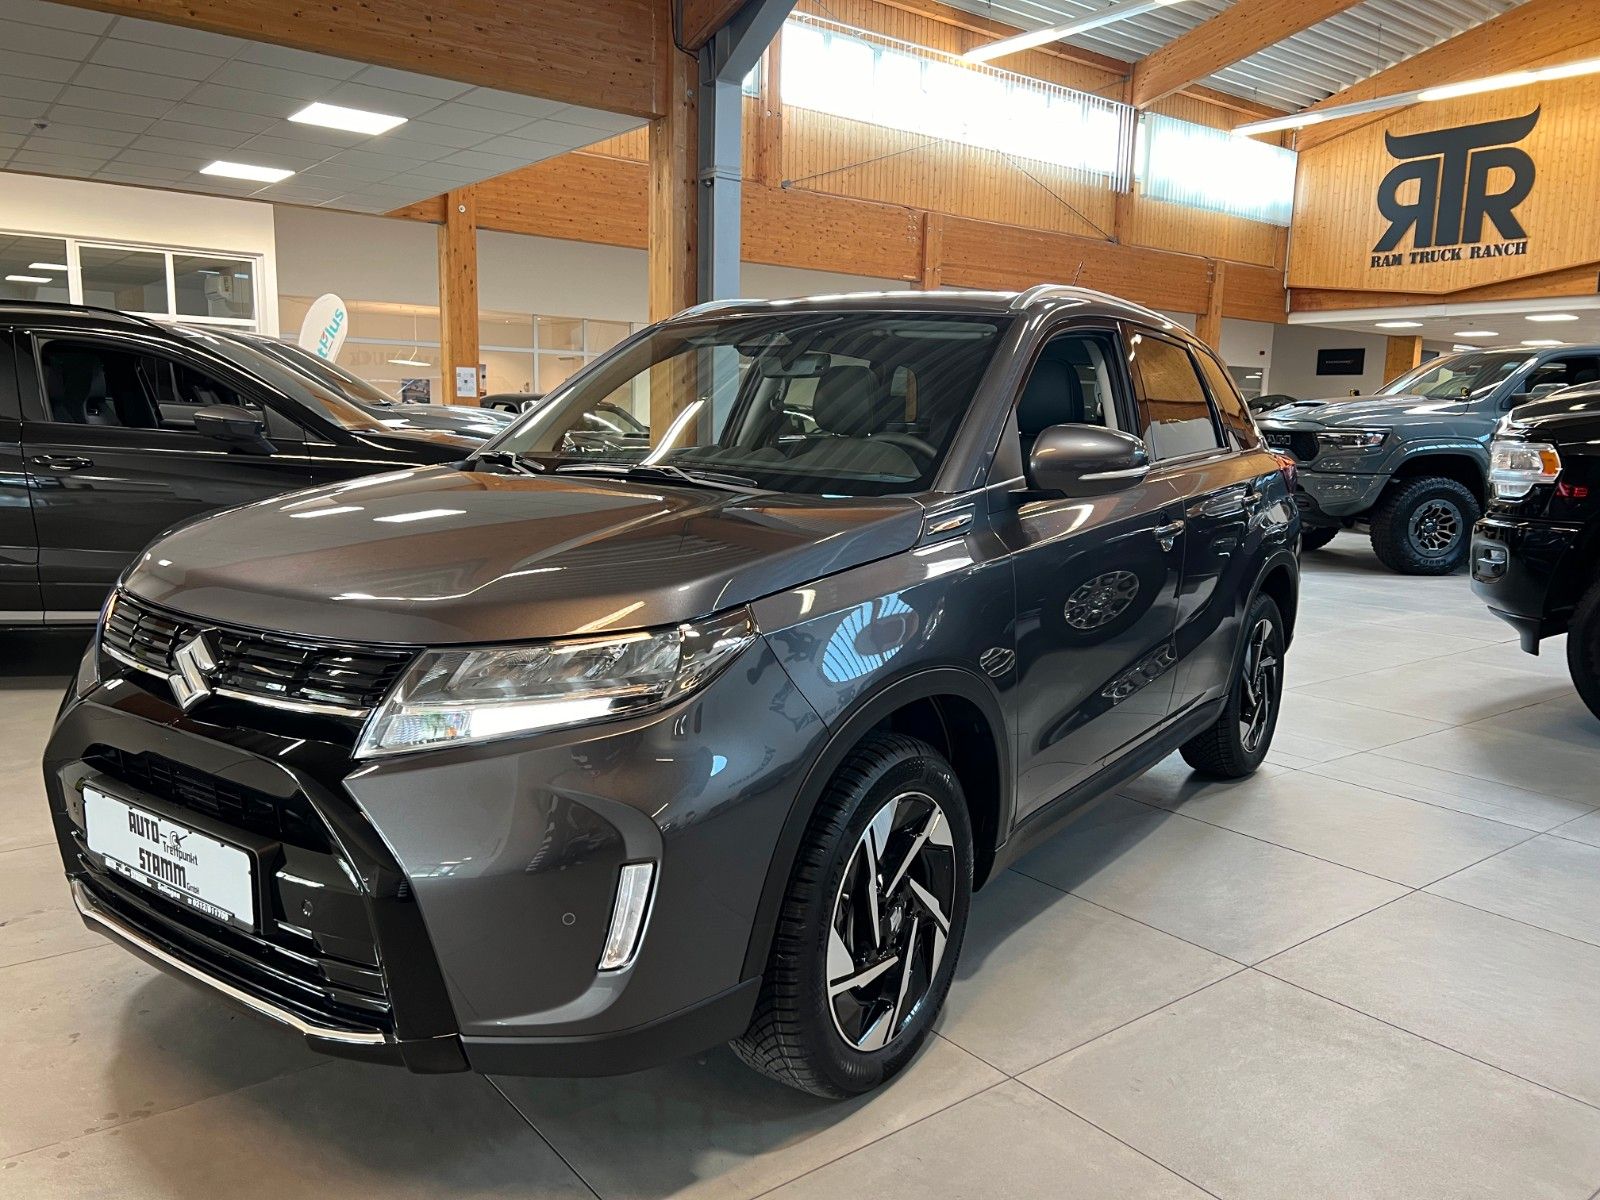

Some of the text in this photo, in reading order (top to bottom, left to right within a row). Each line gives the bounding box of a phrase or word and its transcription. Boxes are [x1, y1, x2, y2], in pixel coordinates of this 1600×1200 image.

[1370, 241, 1528, 268] RAM TRUCK RANCH
[162, 841, 199, 866] Treffpunkt
[139, 848, 187, 889] STAMM
